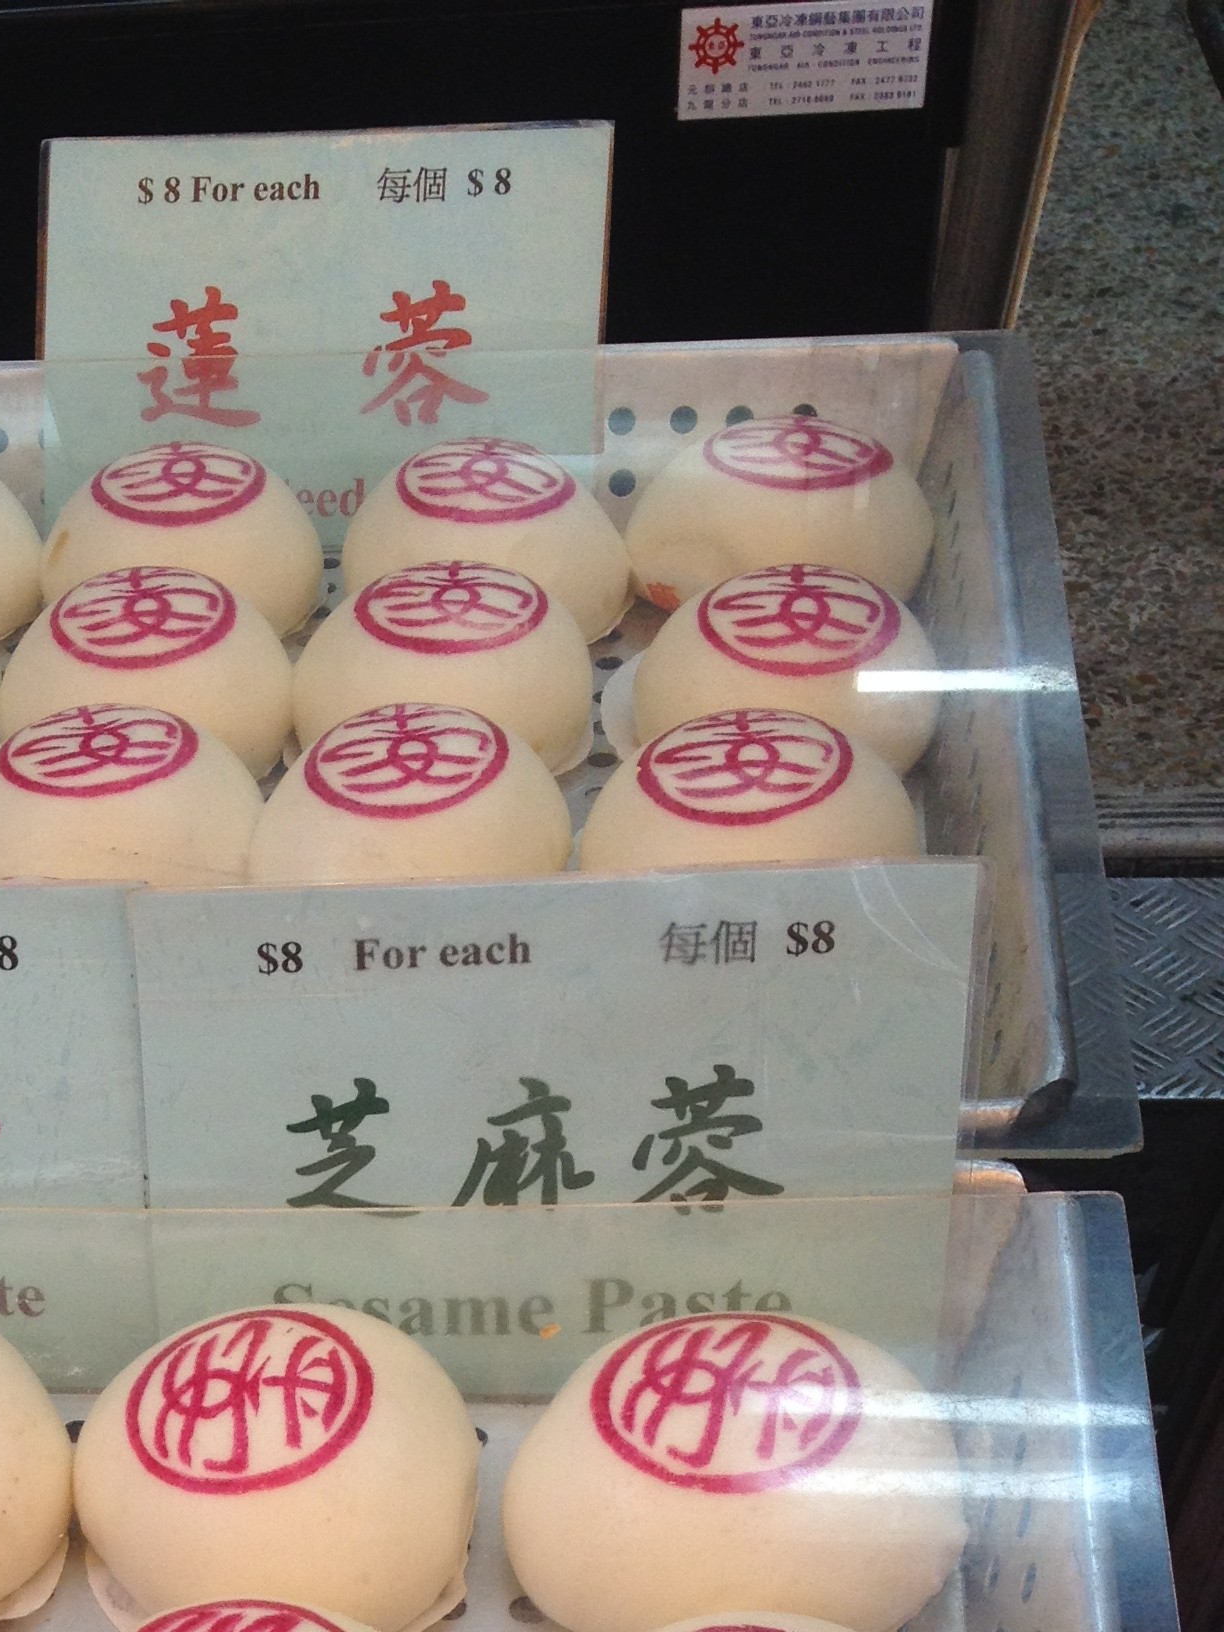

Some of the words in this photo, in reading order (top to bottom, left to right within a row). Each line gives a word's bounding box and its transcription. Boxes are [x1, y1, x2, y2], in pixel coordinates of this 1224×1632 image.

[191, 176, 245, 203] For
[253, 174, 321, 202] each
[377, 166, 447, 204] 每個
[137, 280, 491, 428] 蓮蓉
[284, 477, 365, 518] eed
[257, 940, 304, 976] $8
[353, 937, 426, 971] For
[439, 931, 532, 968] each
[659, 919, 759, 967] 每個
[785, 918, 836, 958] $8
[285, 1063, 785, 1218] 芝麻蓉
